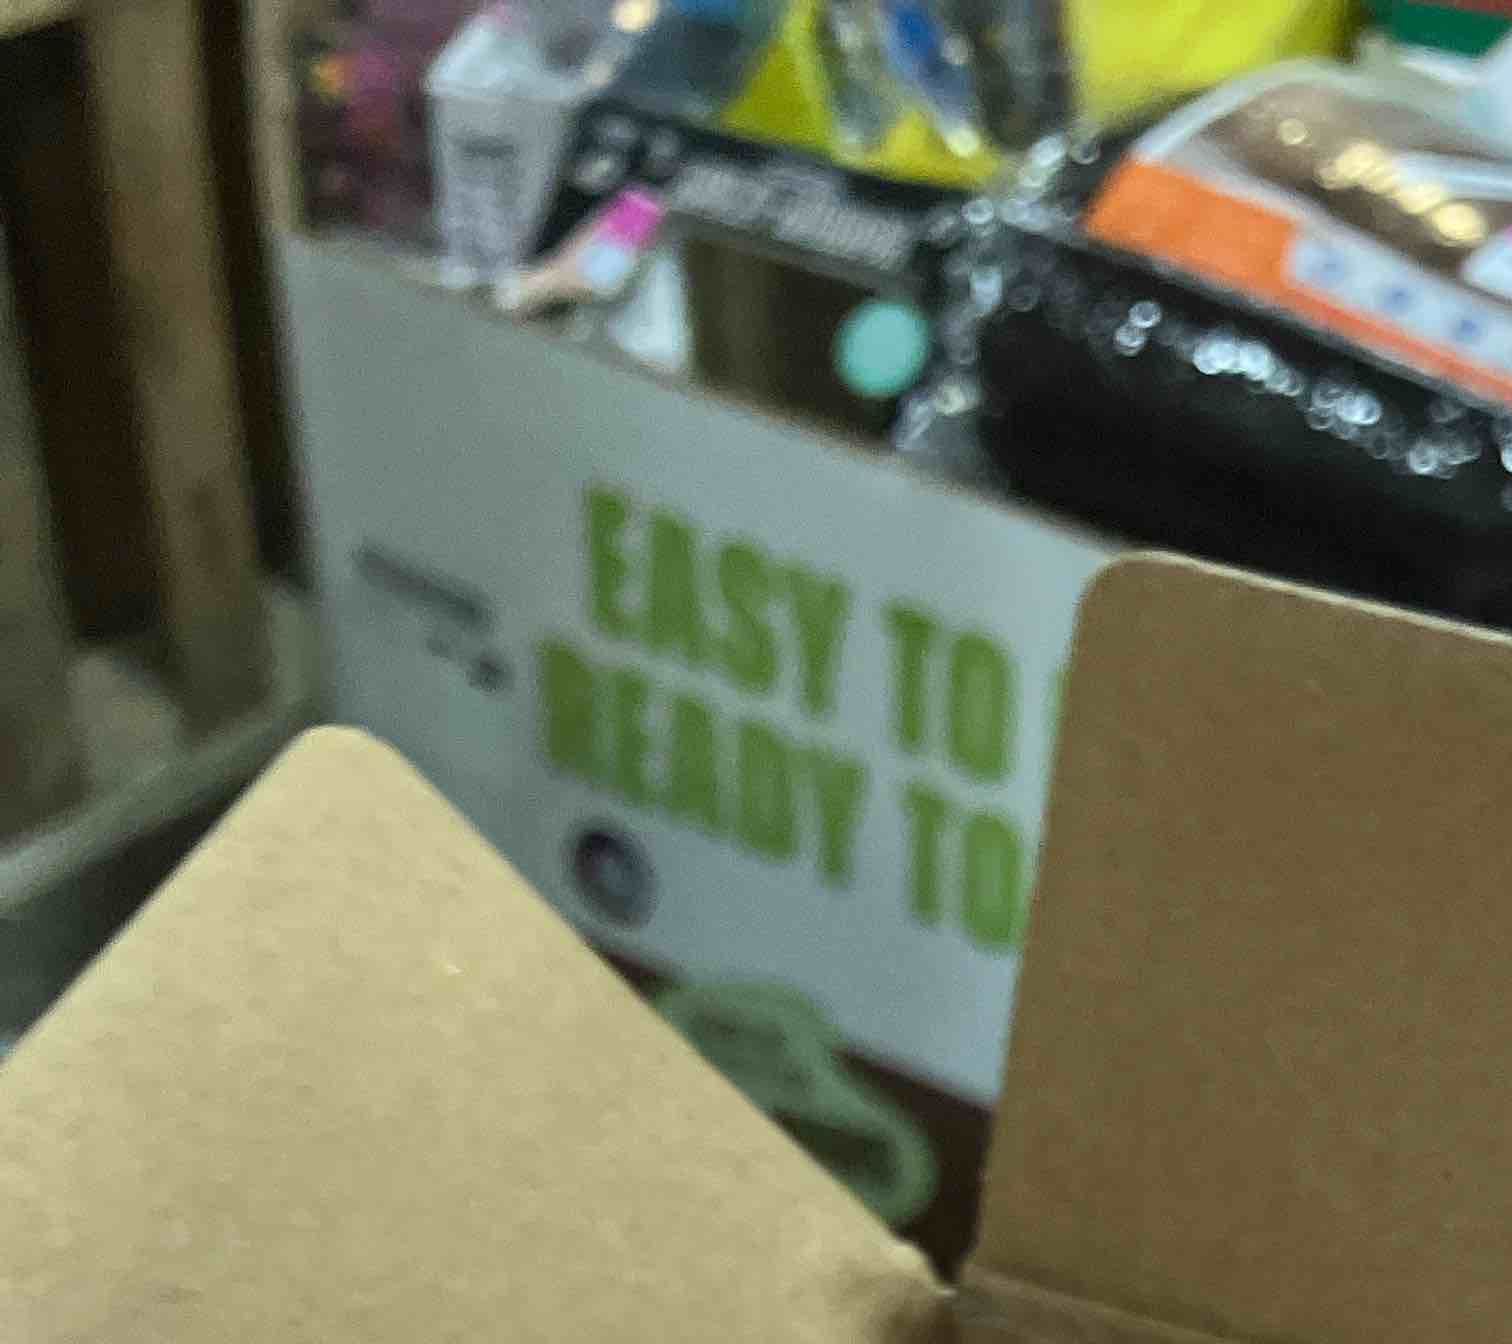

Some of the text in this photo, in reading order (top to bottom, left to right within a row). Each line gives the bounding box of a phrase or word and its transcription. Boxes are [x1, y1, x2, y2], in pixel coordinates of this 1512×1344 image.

[583, 486, 852, 718] EASY
[885, 600, 1018, 786] TO
[902, 777, 1028, 955] TO
